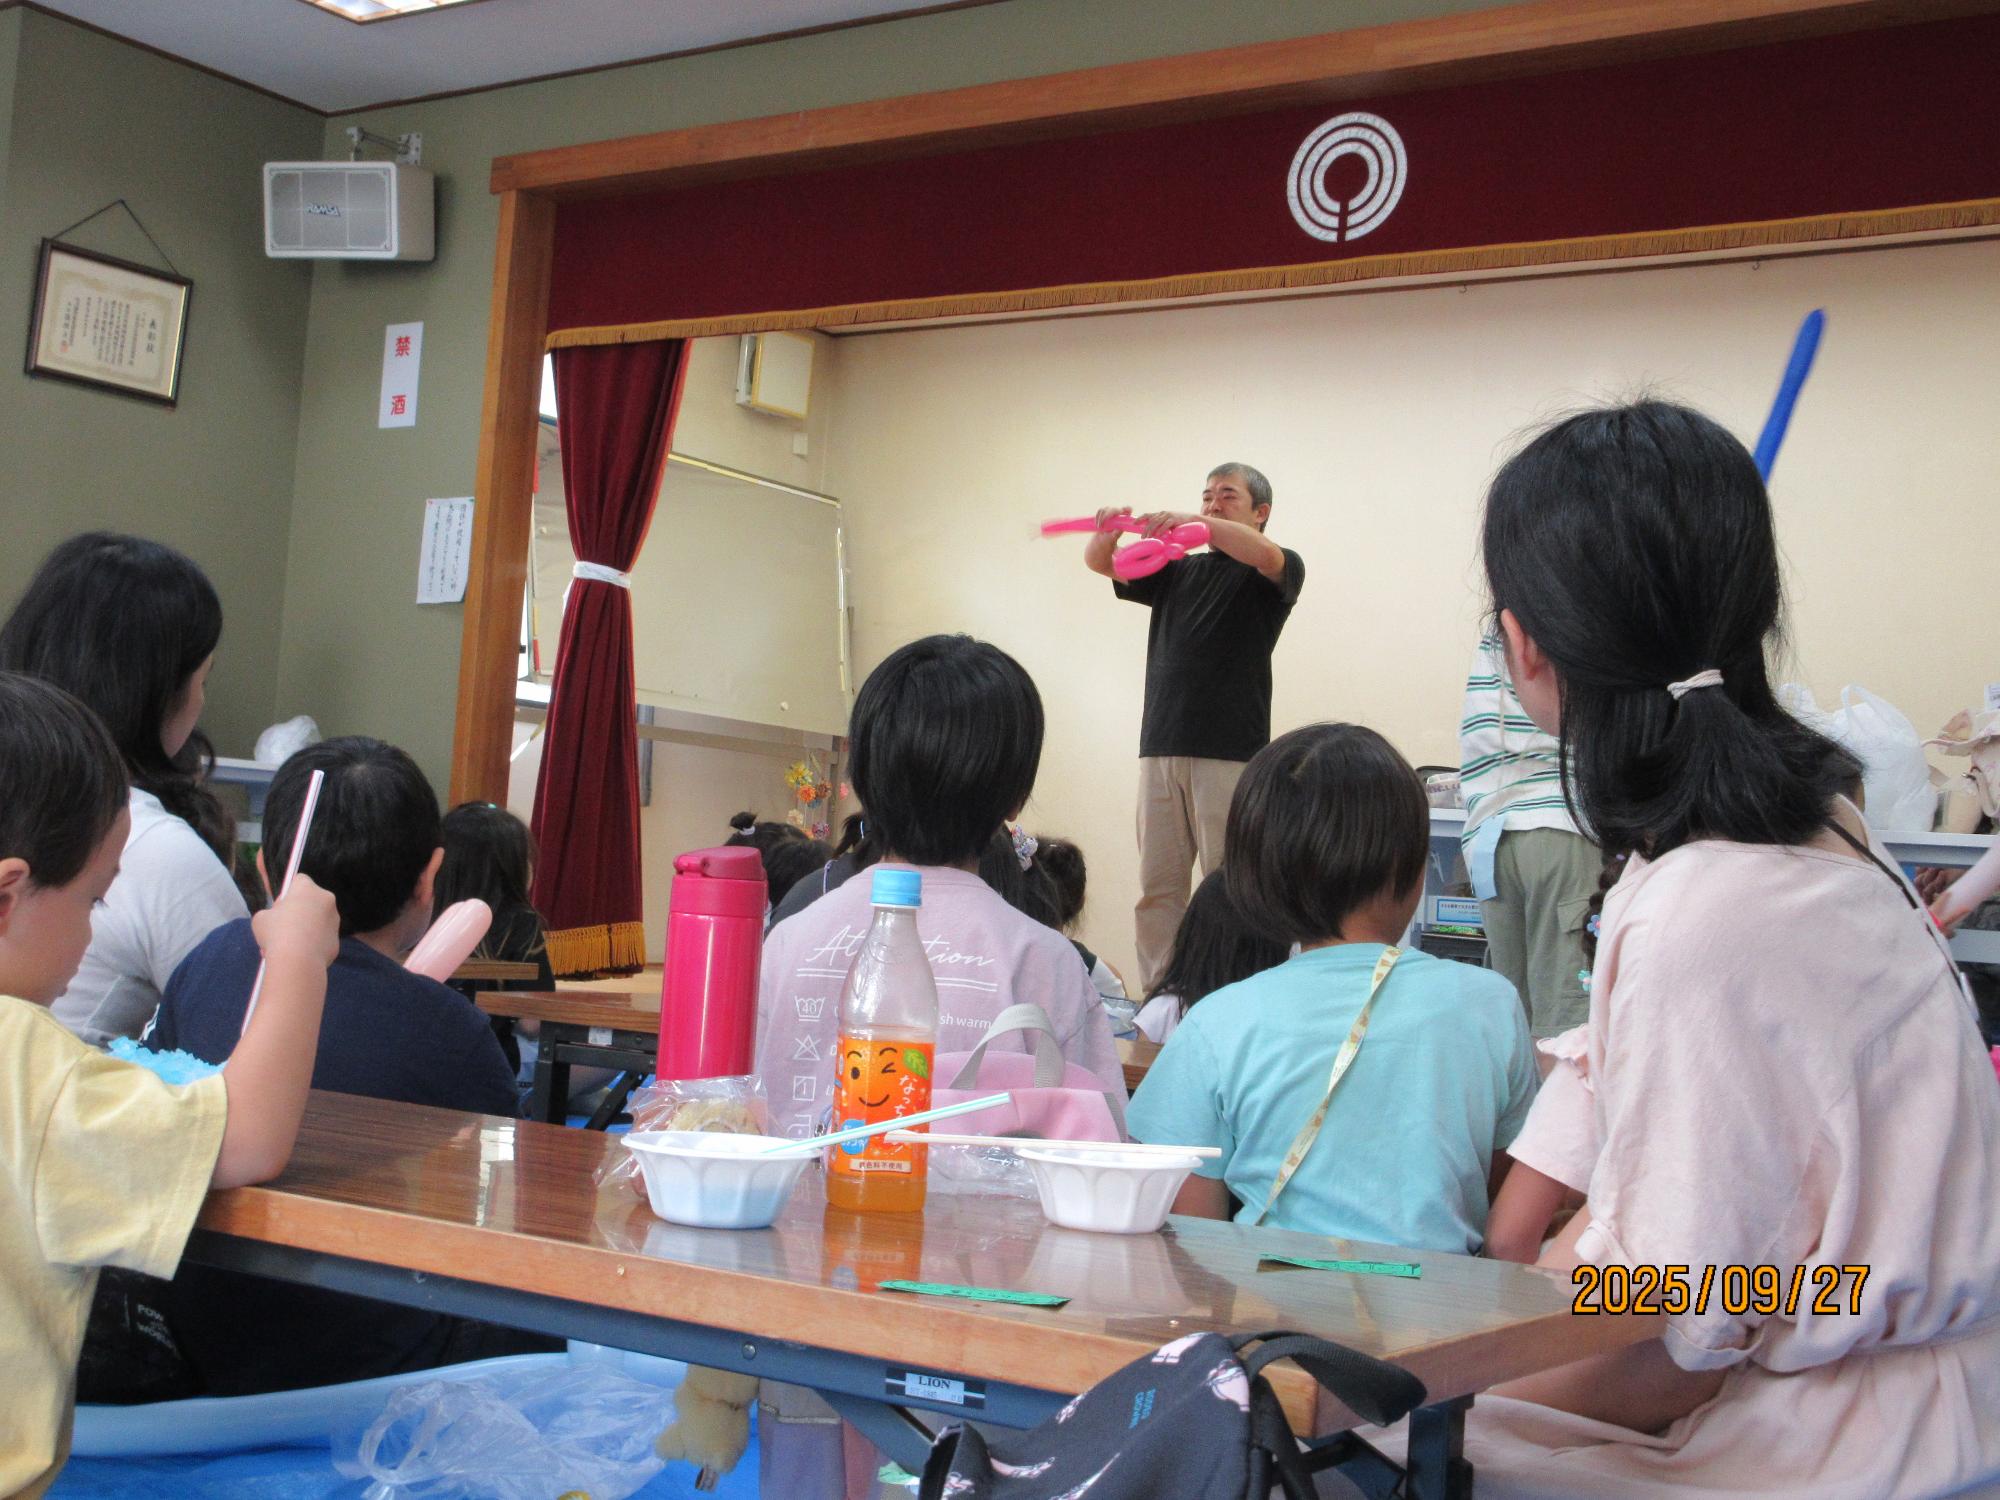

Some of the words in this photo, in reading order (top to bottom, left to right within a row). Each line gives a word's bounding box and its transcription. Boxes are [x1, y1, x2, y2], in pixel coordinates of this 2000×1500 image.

[390, 334, 412, 417] 禁酒
[805, 924, 995, 967] Attion
[918, 1375, 951, 1389] LION
